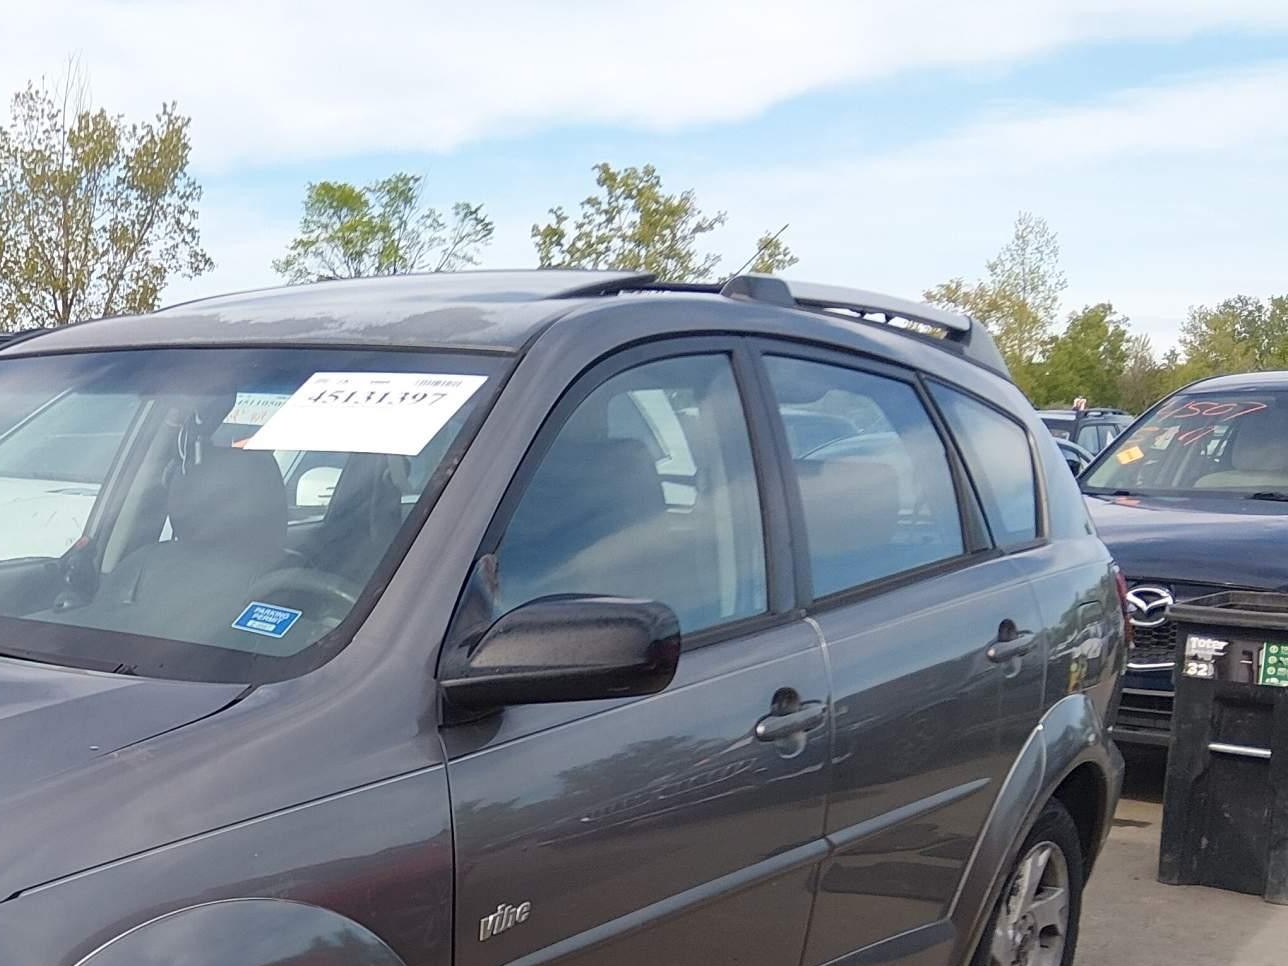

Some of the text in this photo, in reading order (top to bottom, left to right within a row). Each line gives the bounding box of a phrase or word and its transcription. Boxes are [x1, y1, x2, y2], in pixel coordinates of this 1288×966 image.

[308, 389, 448, 407] 45131397
[251, 613, 283, 625] PERMIT
[253, 607, 291, 620] PARKING
[478, 900, 532, 942] vibe
